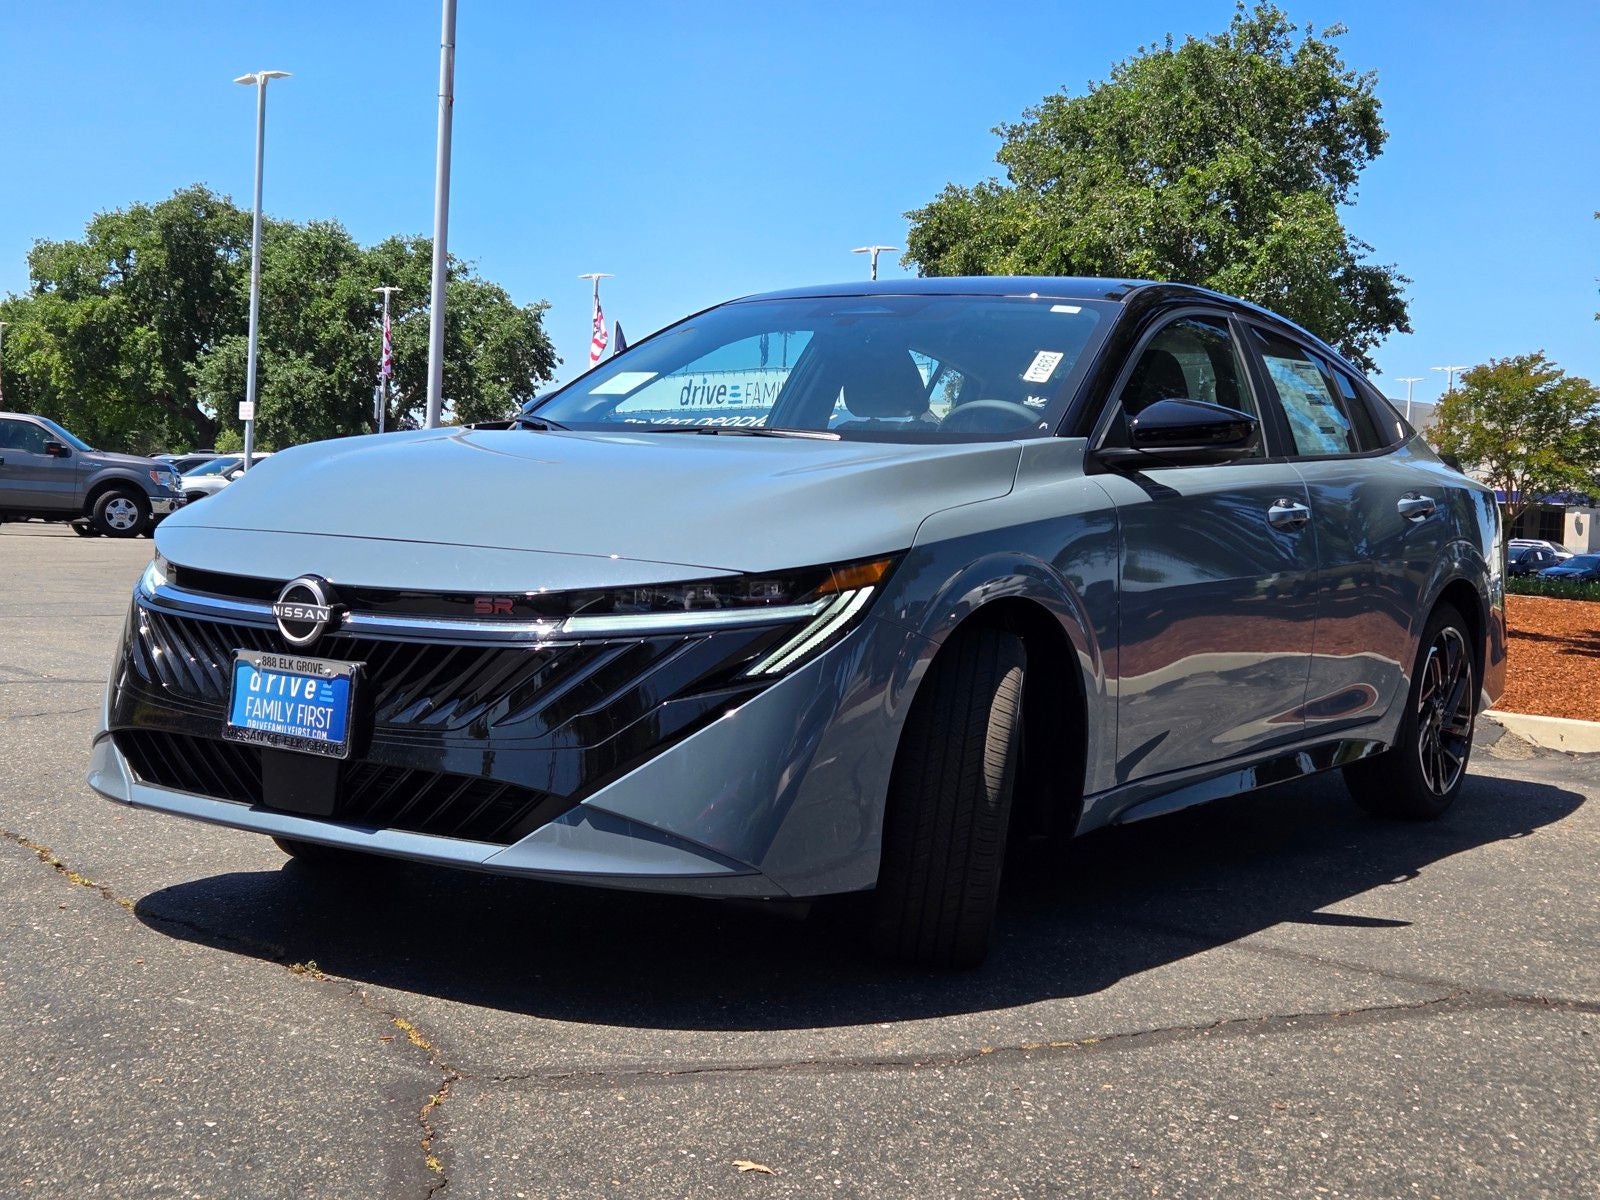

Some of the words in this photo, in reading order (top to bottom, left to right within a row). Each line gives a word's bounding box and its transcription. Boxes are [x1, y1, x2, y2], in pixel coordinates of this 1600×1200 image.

[680, 378, 727, 406] drive
[745, 382, 784, 404] FAMI
[273, 605, 328, 621] NISSAN
[474, 597, 514, 615] SR
[262, 655, 277, 669] 888
[279, 657, 295, 671] ELK
[296, 660, 324, 675] GROVE
[250, 671, 317, 700] drive
[245, 696, 295, 724] FAMILY
[296, 703, 334, 730] FIRST
